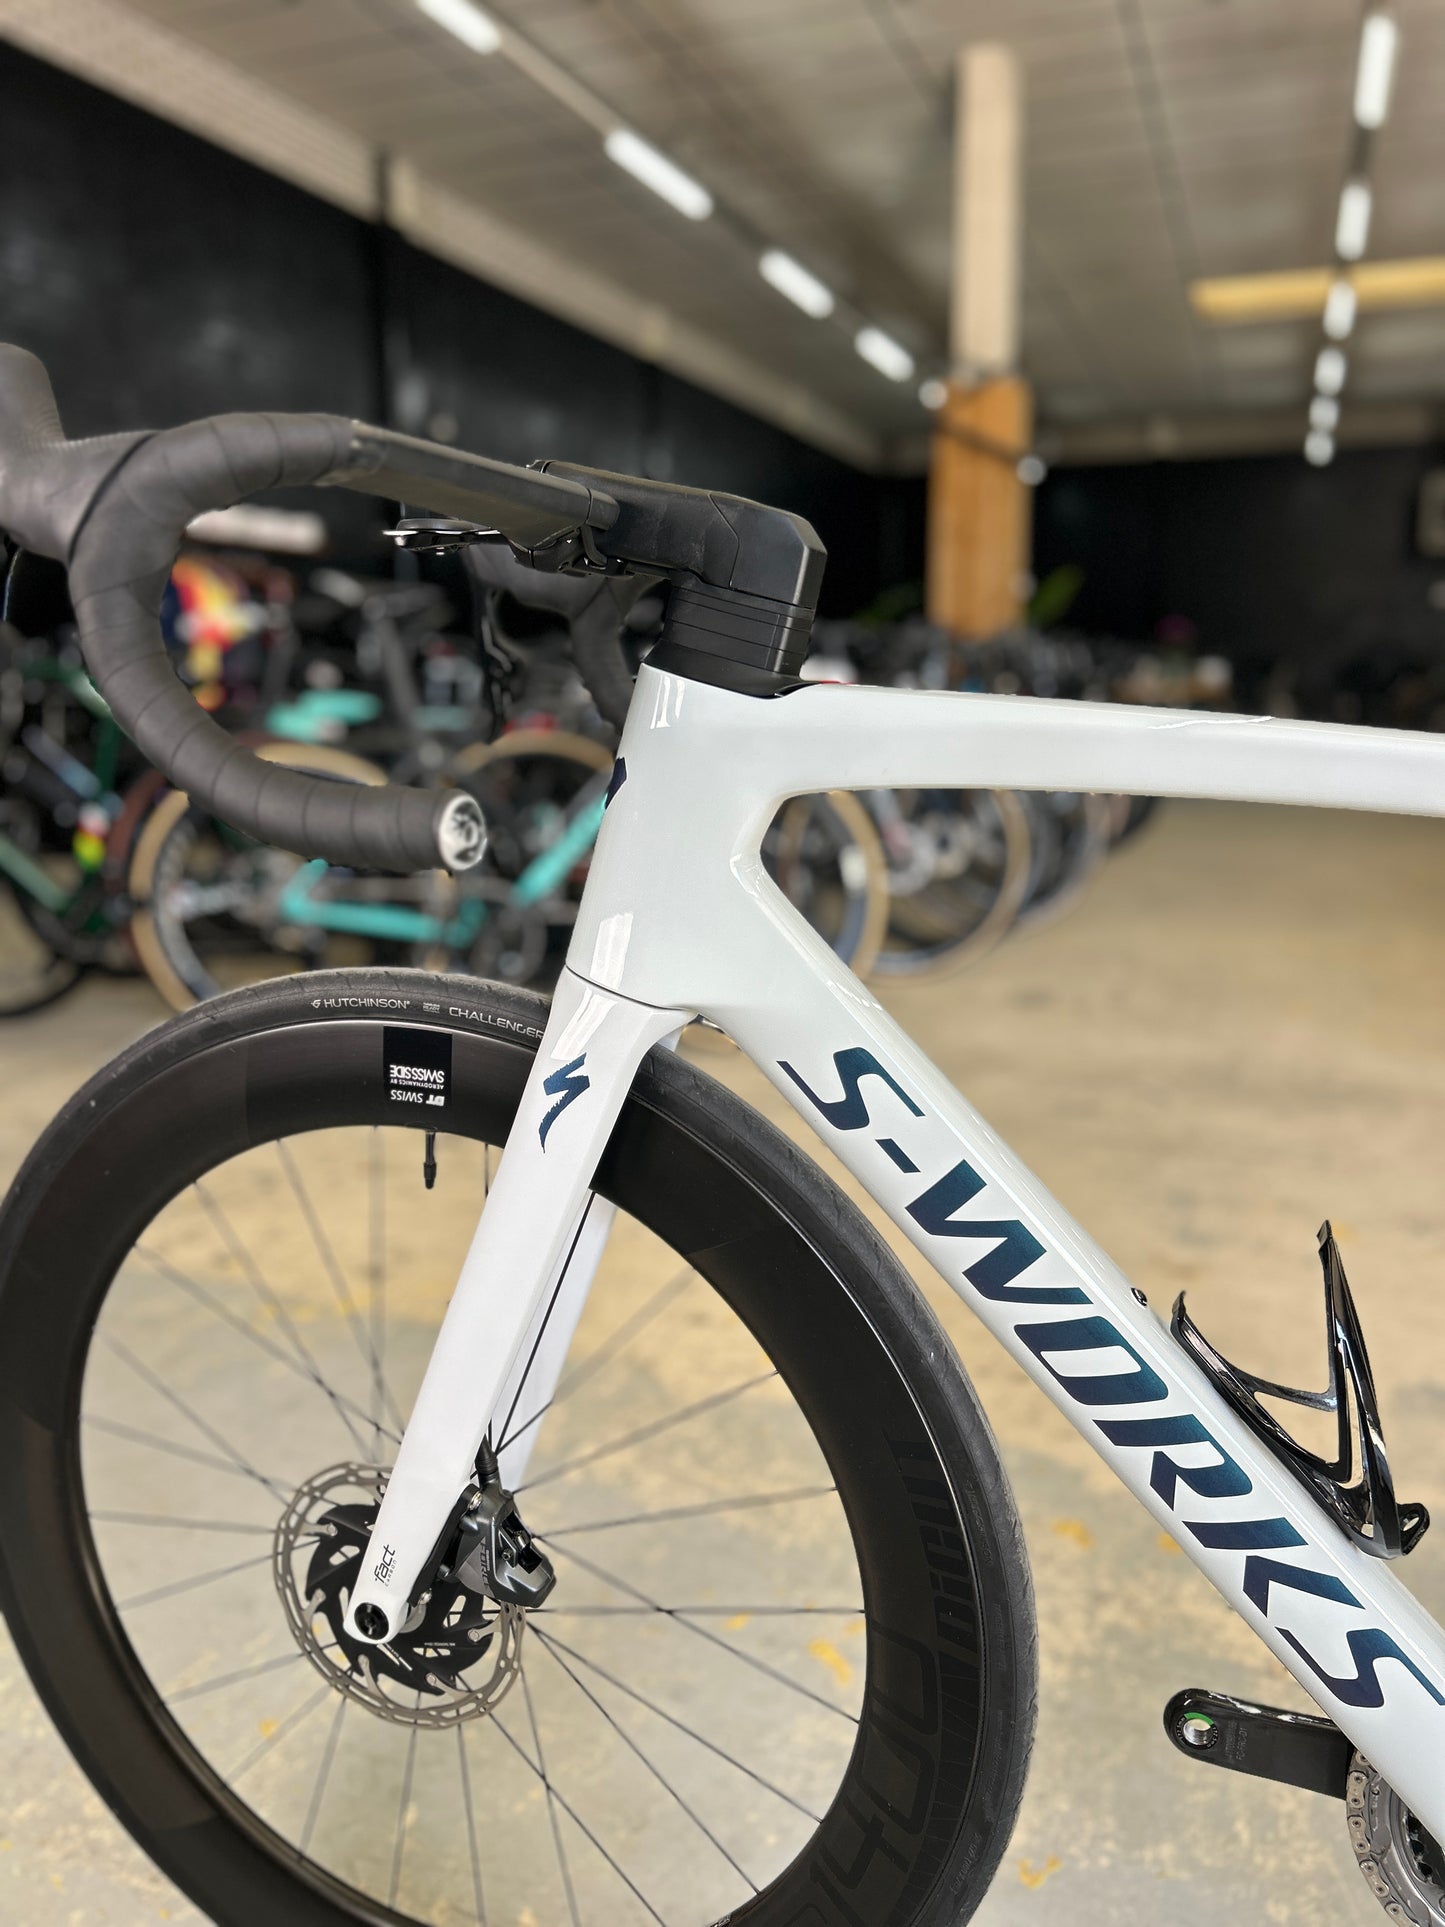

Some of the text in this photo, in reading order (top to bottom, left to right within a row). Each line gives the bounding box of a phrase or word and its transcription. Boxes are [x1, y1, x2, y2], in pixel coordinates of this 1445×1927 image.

[324, 998, 407, 1009] HUTCHINSON
[449, 1006, 544, 1039] CHALLENGER
[399, 1079, 444, 1090] AERODYNAMICS
[391, 1089, 445, 1106] DT SWISS
[777, 1047, 1445, 1708] S-WORKS
